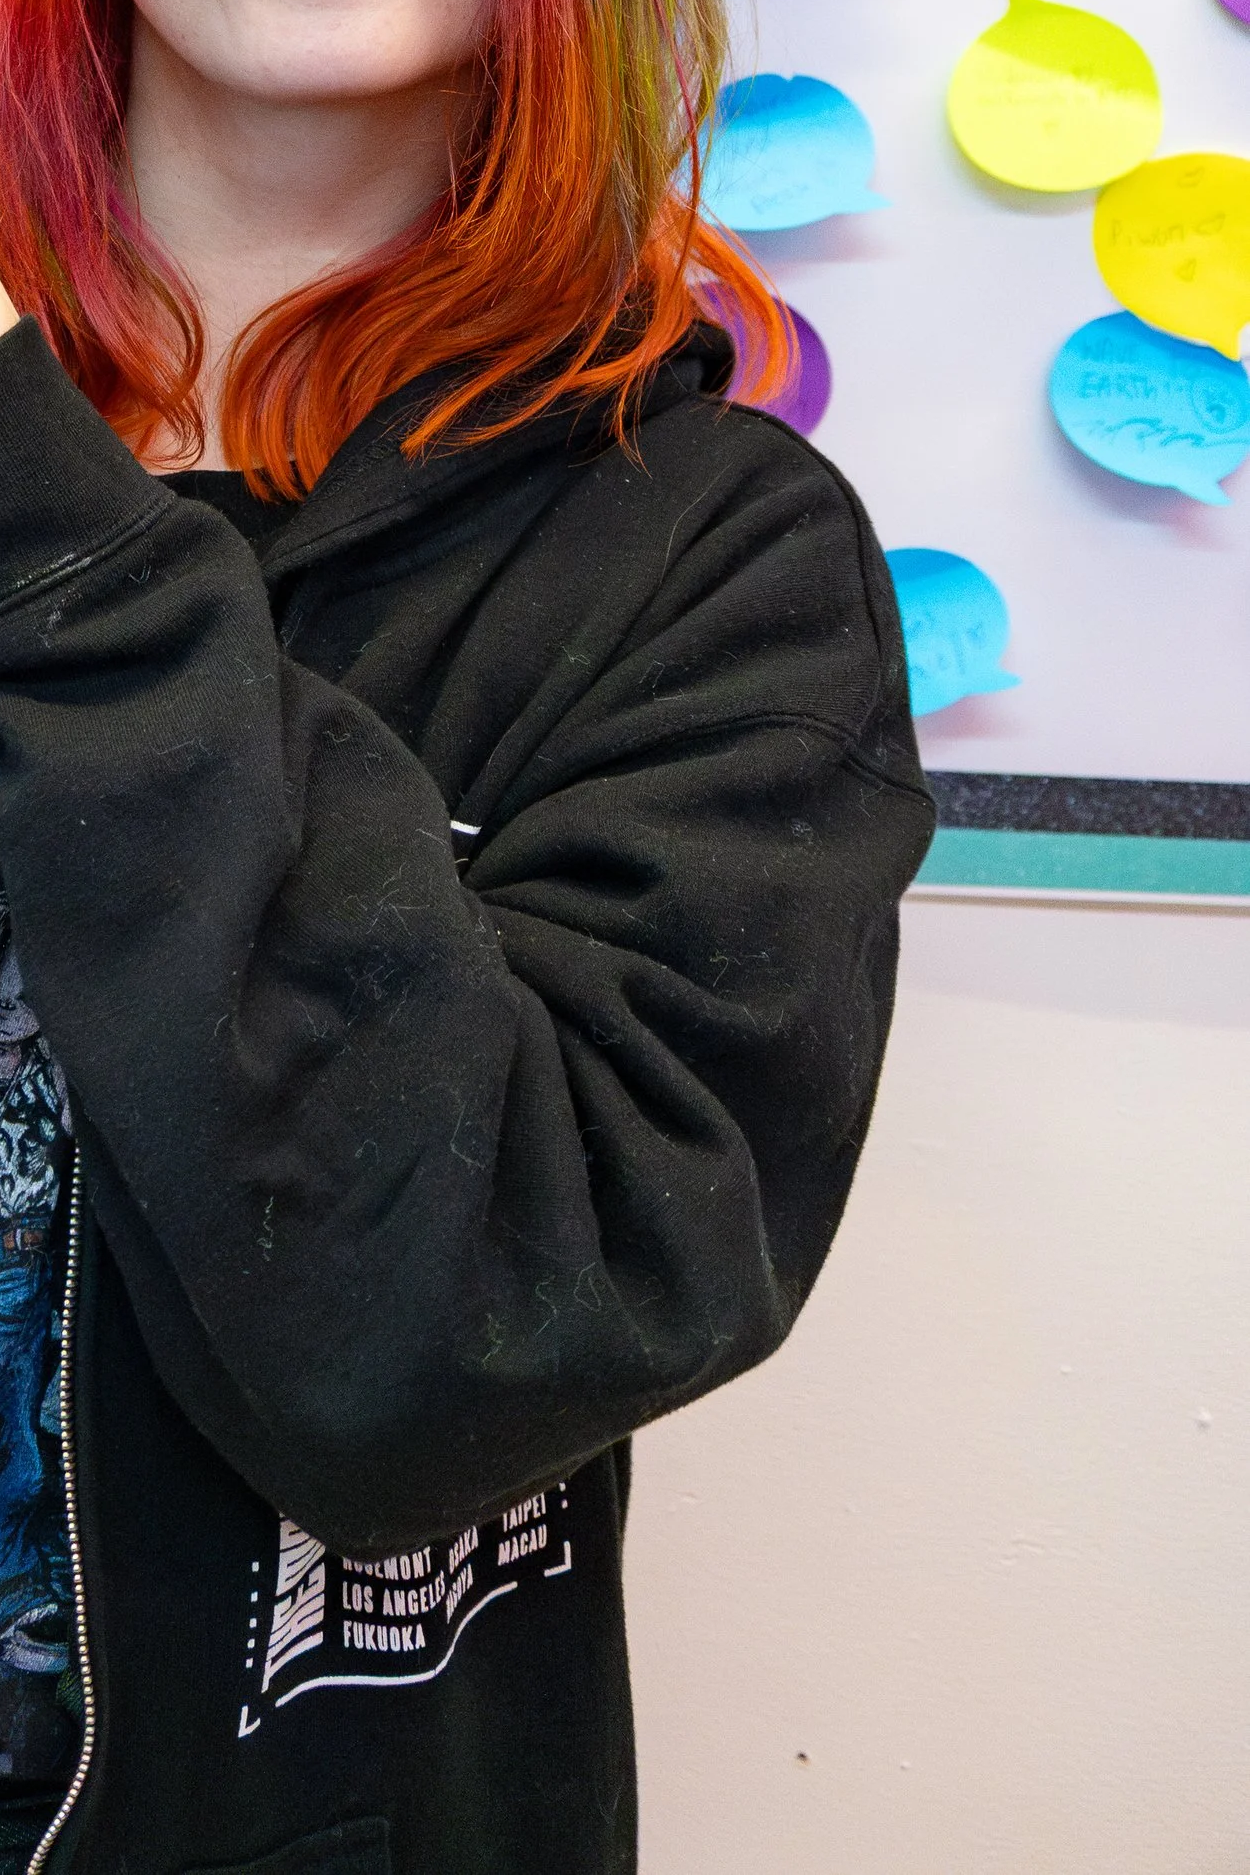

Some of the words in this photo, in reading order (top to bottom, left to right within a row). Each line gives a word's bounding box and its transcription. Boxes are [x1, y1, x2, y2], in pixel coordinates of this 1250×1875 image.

[449, 1525, 479, 1575] OSAKA
[498, 1523, 548, 1566] MACAU
[342, 1581, 374, 1613] LOS
[382, 1568, 446, 1616] ANGELES
[343, 1620, 426, 1652] FUKUOKA
